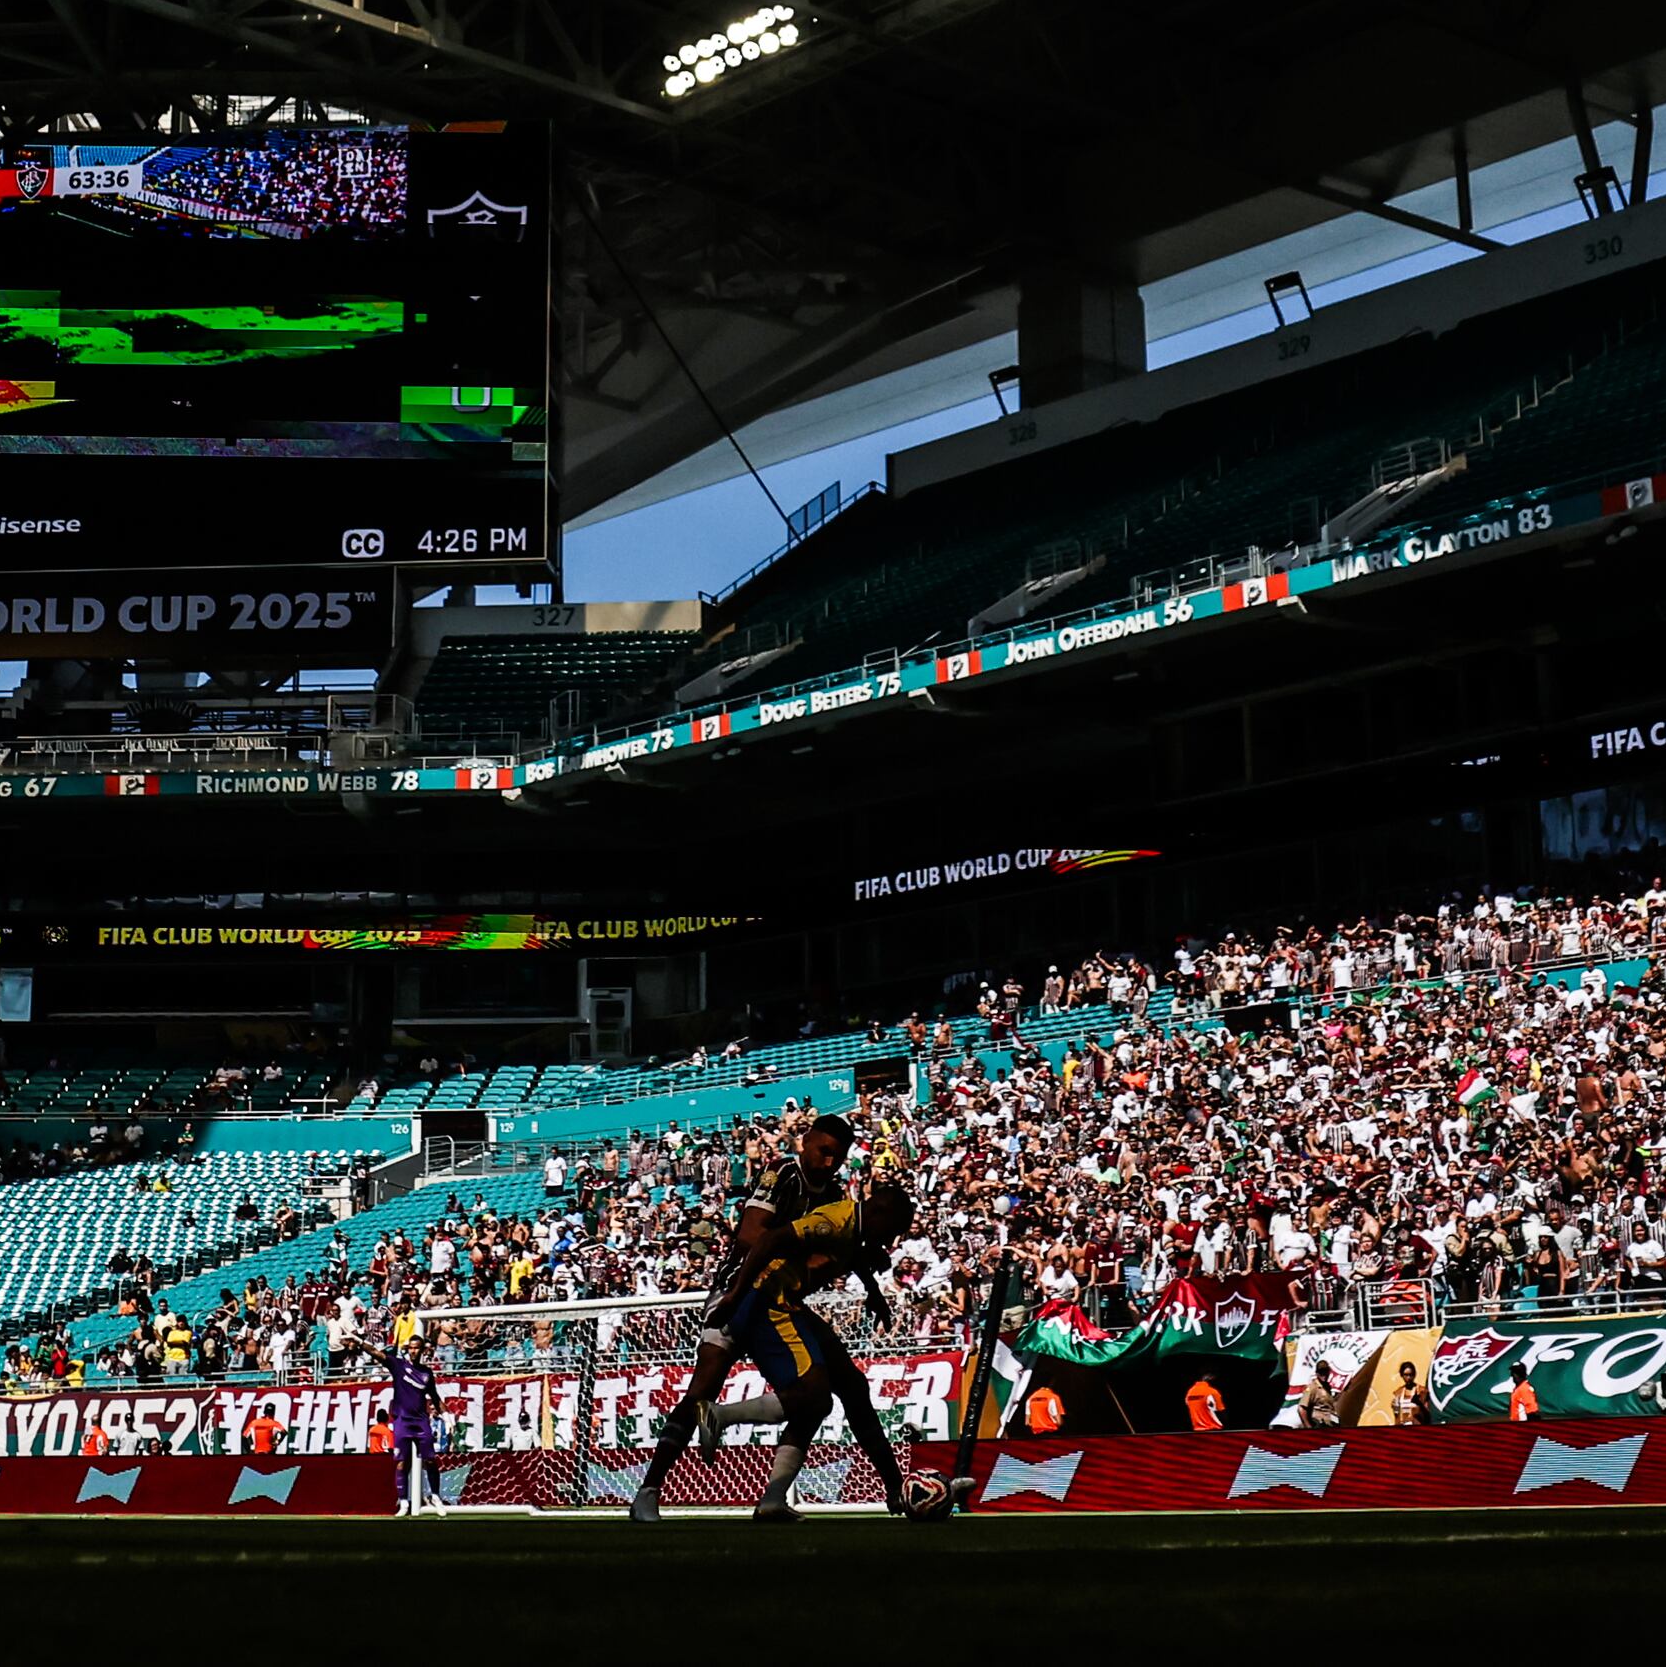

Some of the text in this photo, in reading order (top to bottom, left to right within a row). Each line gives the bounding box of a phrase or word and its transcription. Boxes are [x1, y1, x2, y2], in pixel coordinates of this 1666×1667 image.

[69, 170, 129, 190] 63:36
[1585, 236, 1622, 264] 330
[1278, 336, 1310, 359] 329
[346, 532, 381, 556] CC
[418, 527, 527, 554] 4:26 PM
[1332, 504, 1553, 583] MARK CLAYTON 83
[117, 593, 219, 633] CUP
[533, 608, 574, 626] 327
[1005, 599, 1194, 666] JOHN OFFERDAHL 56
[760, 671, 902, 726] DOUG BETTERS 75
[525, 758, 557, 784] BOB
[650, 727, 675, 753] 73
[1590, 728, 1646, 761] FIFA
[24, 777, 58, 797] 67
[196, 770, 420, 795] RICHMOND WEBB 78
[853, 879, 892, 902] FIFA
[894, 866, 940, 894] CLUB
[944, 851, 1012, 886] WORLD
[98, 926, 147, 946] FIFA
[152, 926, 213, 945] CLUB
[218, 926, 306, 945] WORLD
[578, 917, 639, 941] CLUB
[643, 915, 708, 939] WORLD
[391, 1124, 410, 1135] 126
[500, 1122, 515, 1134] 129
